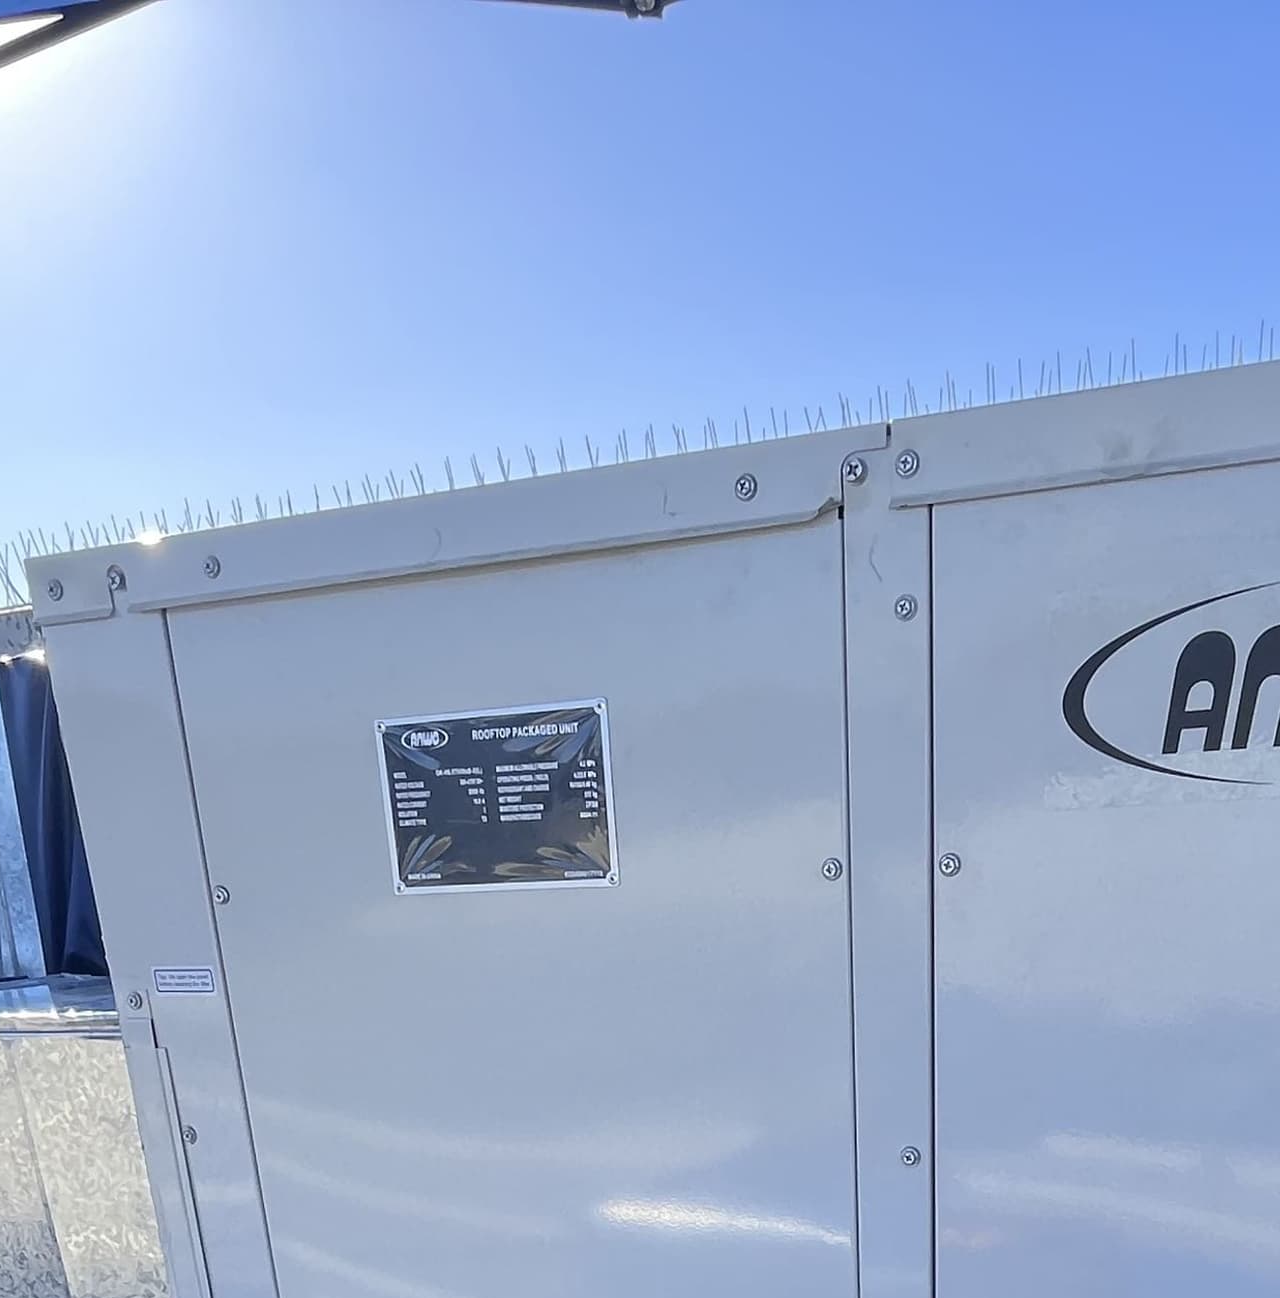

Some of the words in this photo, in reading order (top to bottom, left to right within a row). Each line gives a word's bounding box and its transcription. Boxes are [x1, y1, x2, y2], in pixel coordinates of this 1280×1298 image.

[471, 727, 512, 741] ROOFTOP
[513, 724, 559, 738] PACKAGED
[559, 722, 579, 735] UNIT
